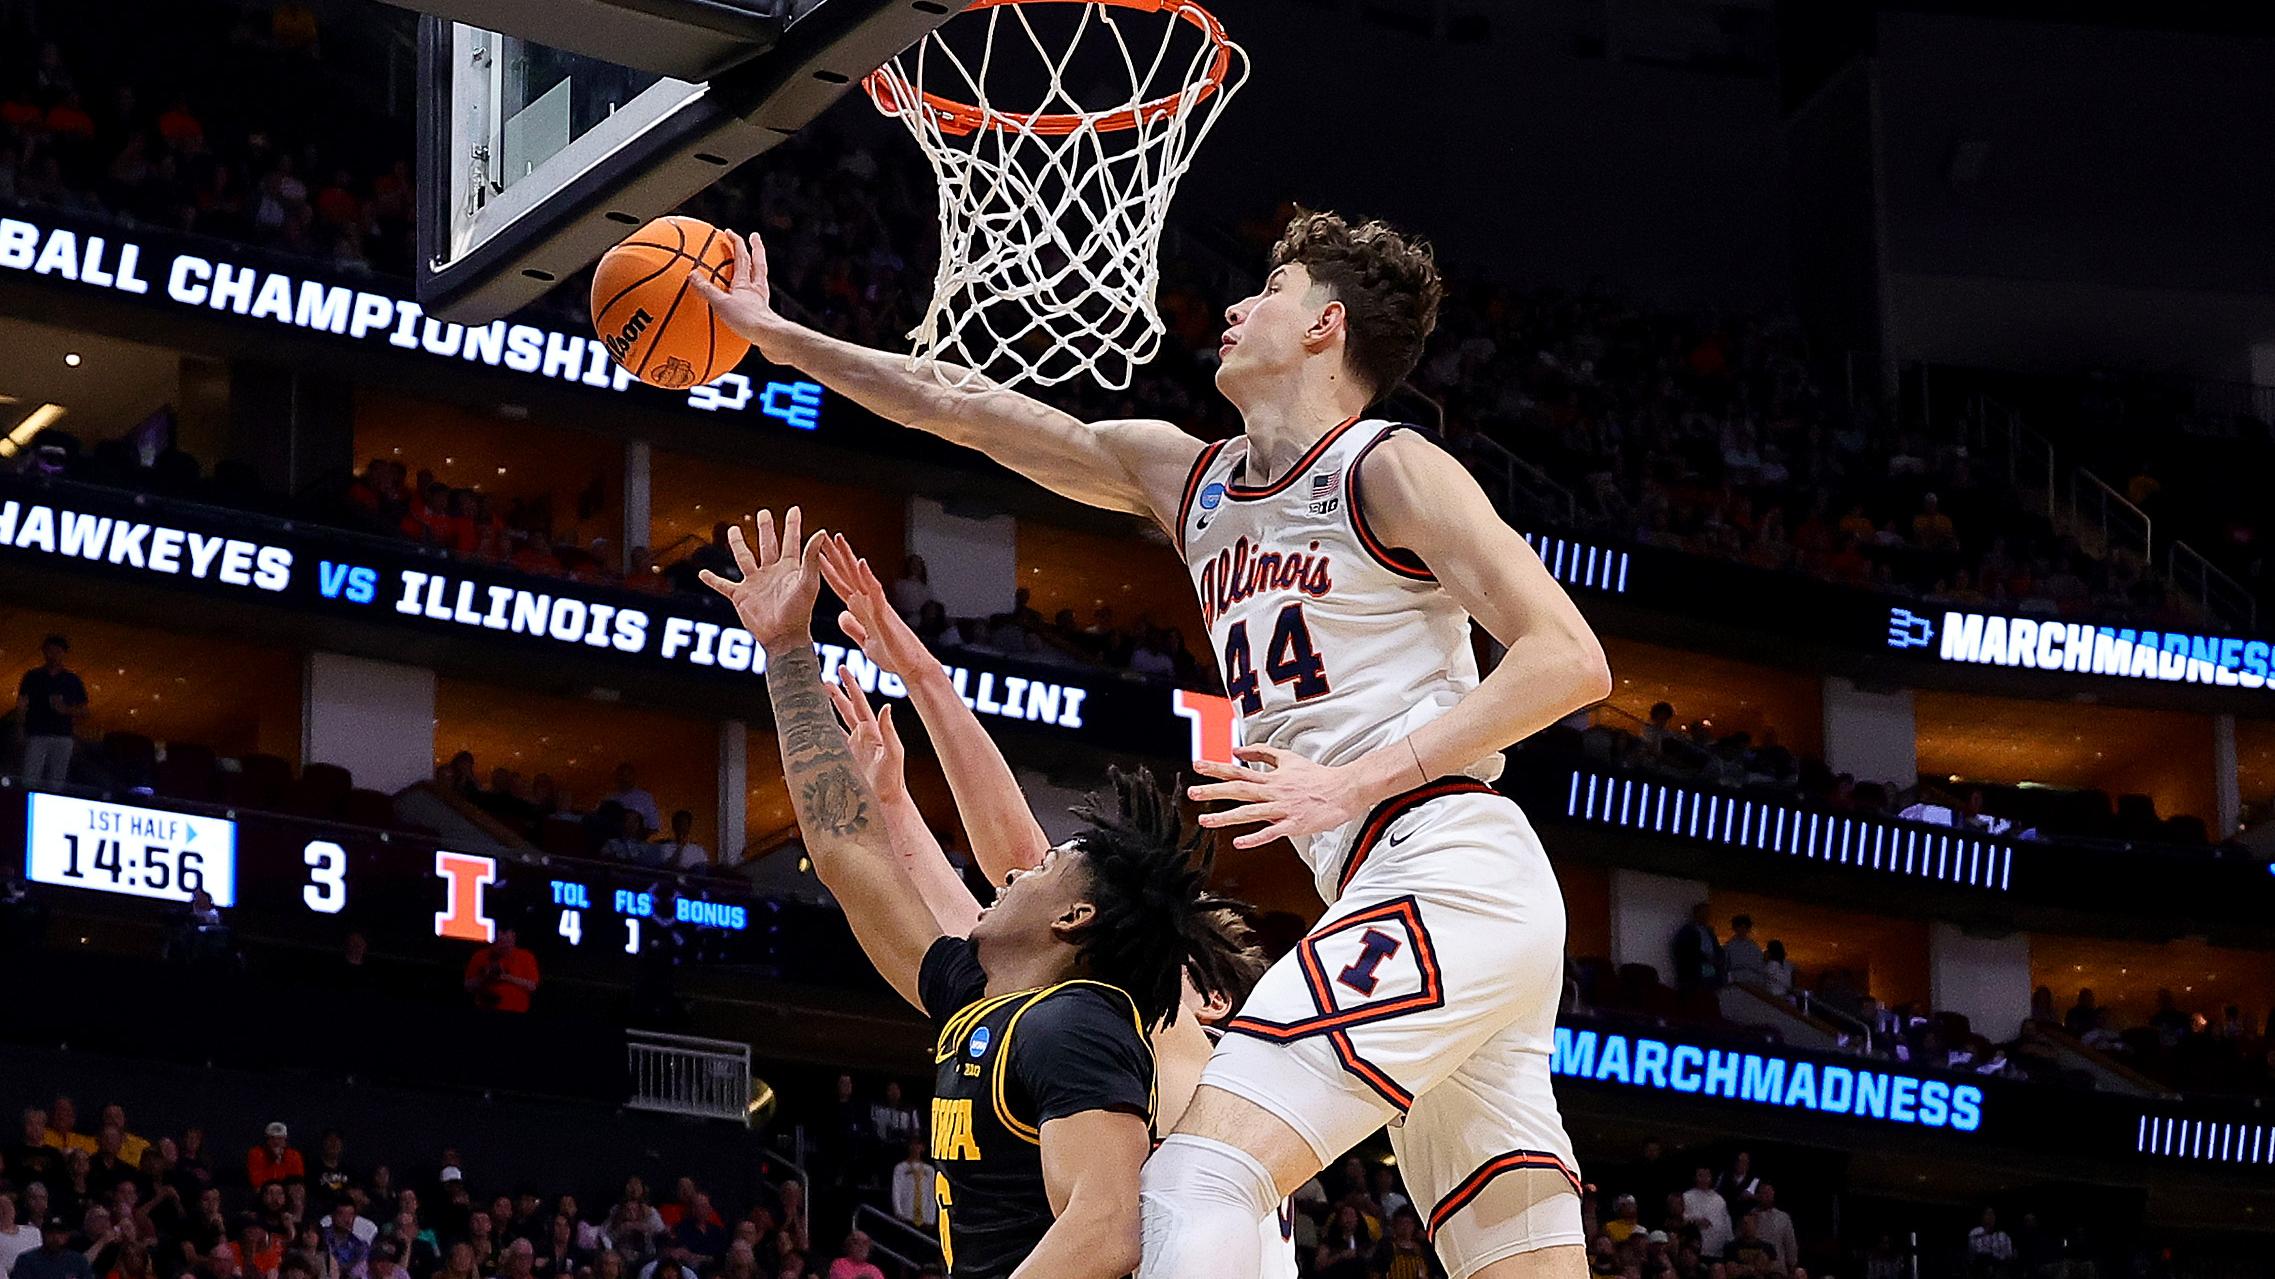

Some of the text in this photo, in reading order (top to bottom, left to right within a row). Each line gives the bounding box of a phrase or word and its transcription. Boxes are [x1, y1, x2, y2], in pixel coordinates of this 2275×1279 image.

[0, 218, 148, 294] BALL
[605, 308, 654, 362] lson
[1200, 535, 1333, 634] Illinois
[319, 560, 378, 604] VS
[396, 570, 649, 652] ILLINOIS
[661, 616, 911, 699] FIGIN
[943, 664, 1086, 728] LLINI
[1224, 602, 1332, 718] 44
[1940, 611, 2275, 689] MARCHMADNES
[88, 808, 178, 841] 1ST HALF
[62, 834, 203, 893] 14:56
[303, 840, 346, 914] 3
[551, 881, 747, 930] TOL FLS BONUS
[558, 909, 582, 946] 4
[1550, 1027, 1983, 1132] MARCHMADNESS
